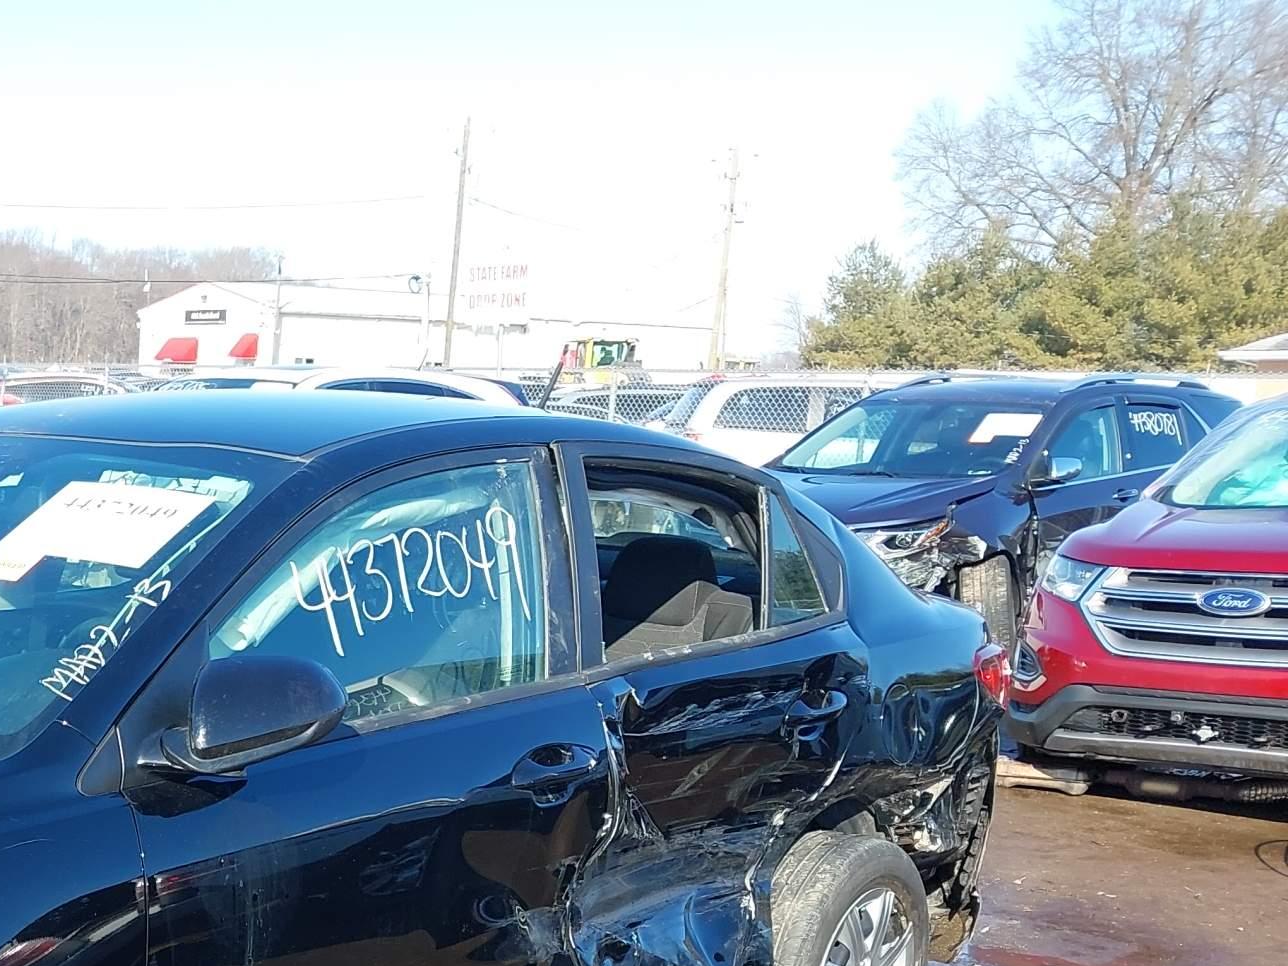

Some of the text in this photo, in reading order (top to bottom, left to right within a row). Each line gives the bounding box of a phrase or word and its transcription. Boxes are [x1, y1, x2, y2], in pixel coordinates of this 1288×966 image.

[469, 264, 528, 282] STATE FARM
[500, 291, 527, 308] ZONE
[289, 505, 532, 657] 44372049
[1212, 593, 1253, 609] Ford
